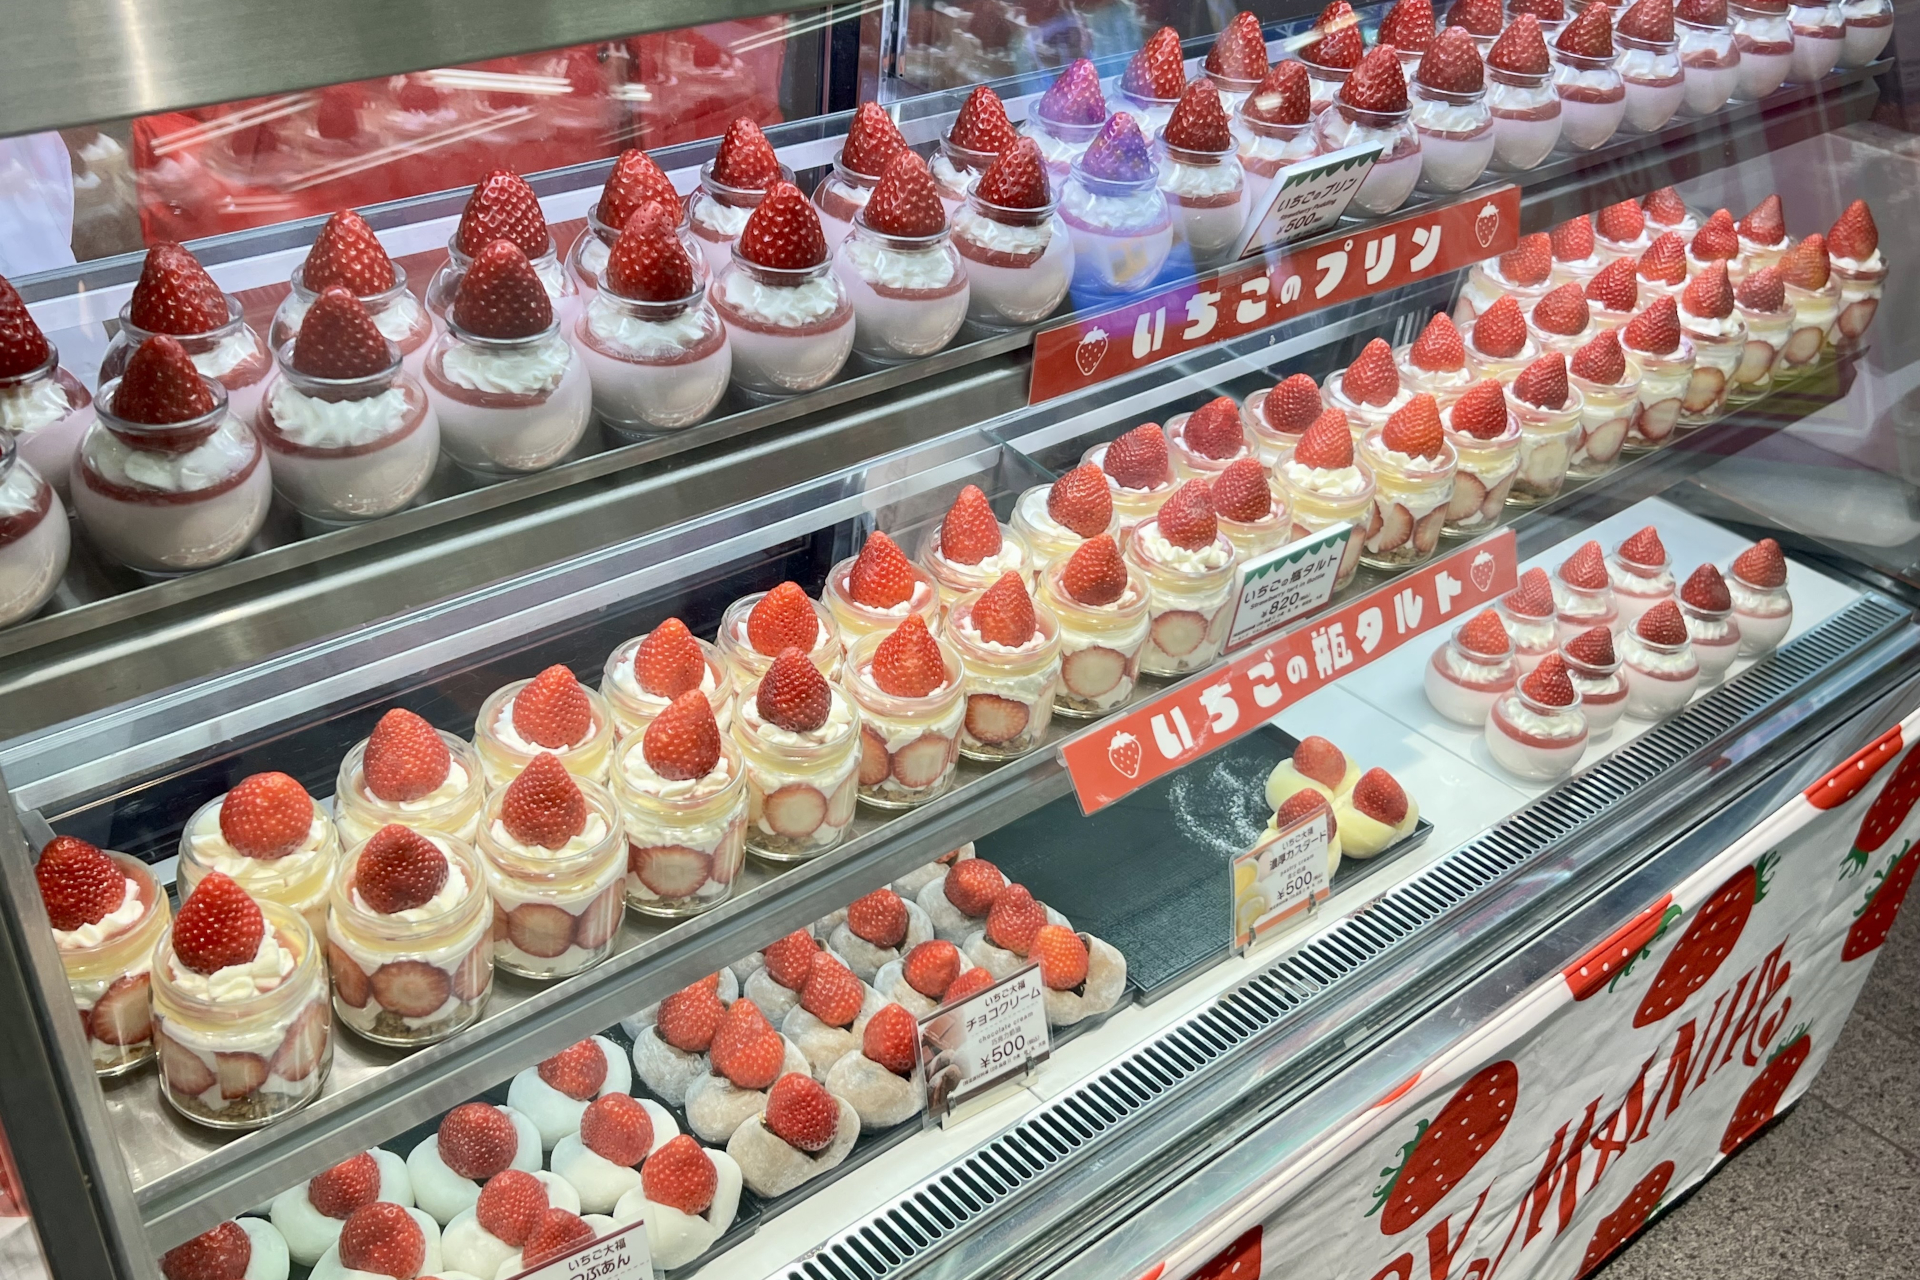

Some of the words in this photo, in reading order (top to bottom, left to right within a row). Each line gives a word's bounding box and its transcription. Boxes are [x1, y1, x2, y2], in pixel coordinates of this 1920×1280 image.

[1312, 198, 1337, 213] Pudding
[1132, 225, 1442, 359] いちごのプリン
[1249, 590, 1286, 610] Strawberry
[1150, 570, 1463, 760] いちごの瓶タルト
[1269, 830, 1328, 871] 濃厚カスタード
[1282, 826, 1315, 850] いちご大福
[985, 979, 1026, 1007] いちご大福
[966, 987, 1041, 1033] チョコクリーム
[978, 1021, 1012, 1044] chocolate
[1012, 1011, 1034, 1027] cream
[568, 1237, 627, 1271] いちご大福
